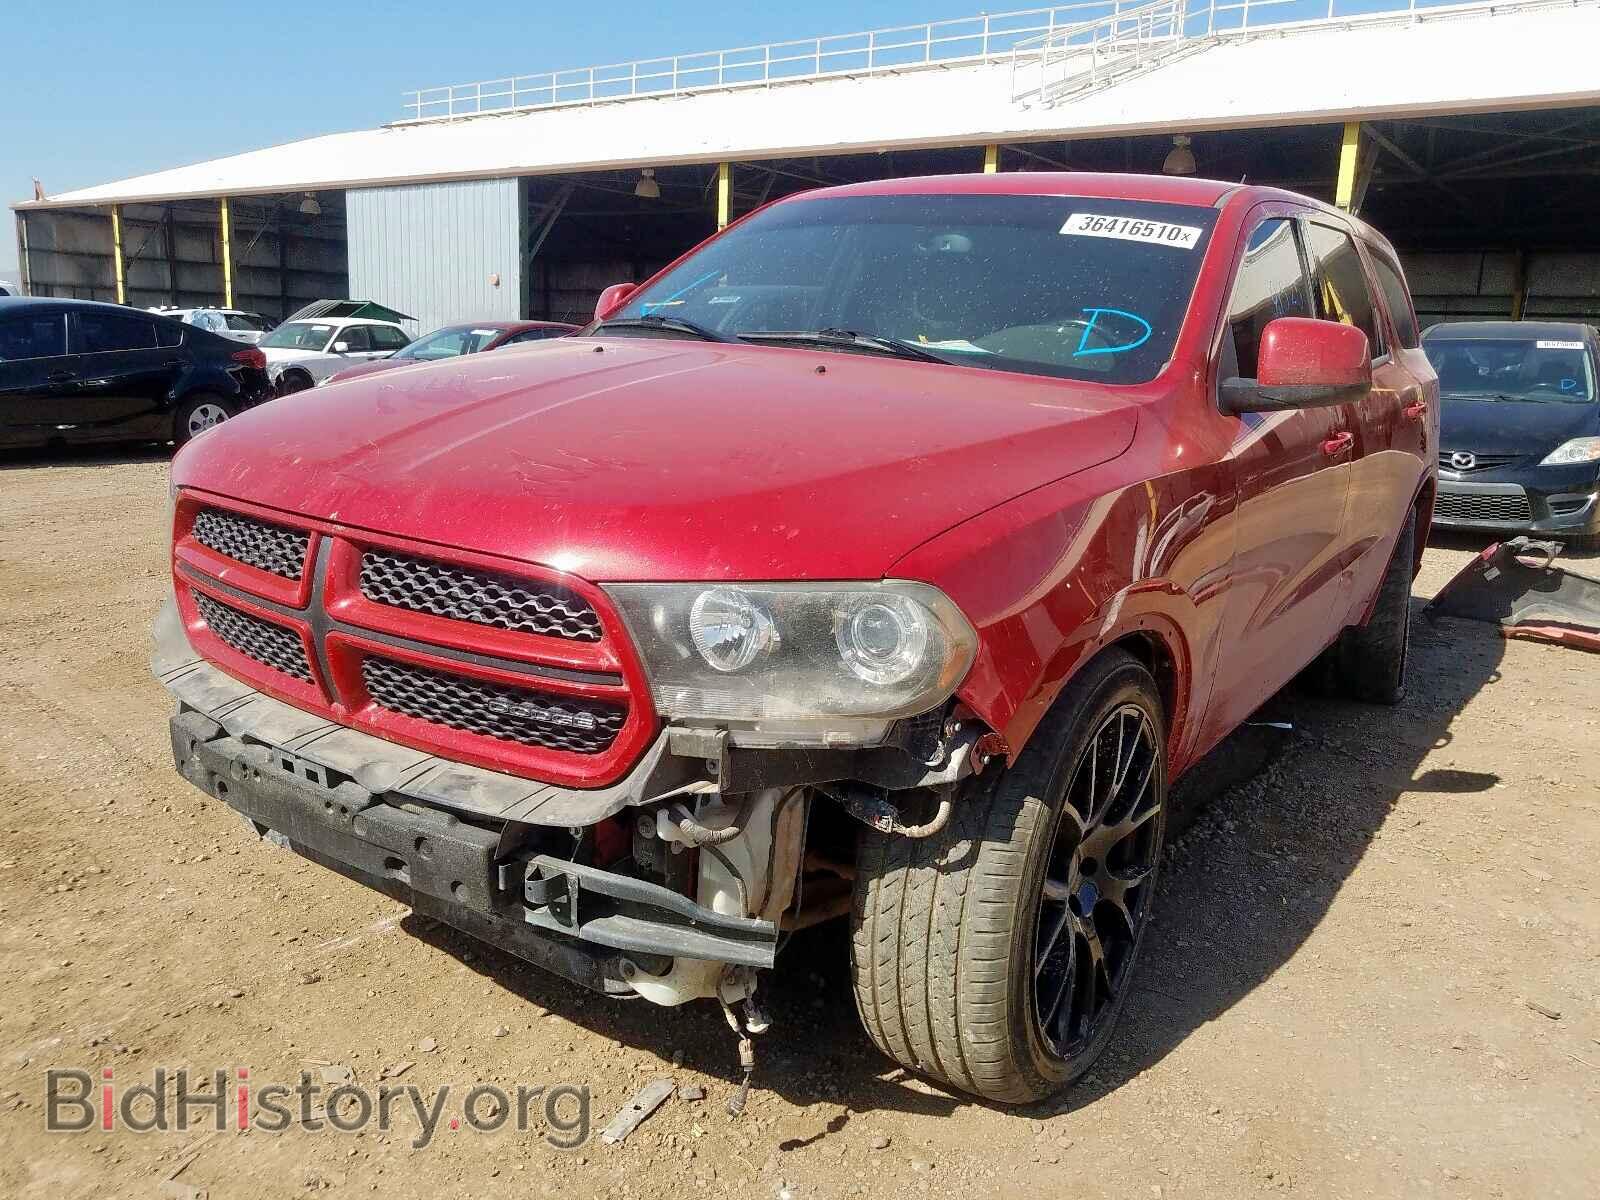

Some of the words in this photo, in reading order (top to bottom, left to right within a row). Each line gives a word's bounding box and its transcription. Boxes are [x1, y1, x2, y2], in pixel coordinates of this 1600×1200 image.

[1072, 308, 1152, 356] D
[1560, 378, 1577, 392] D
[487, 699, 598, 730] DODGE
